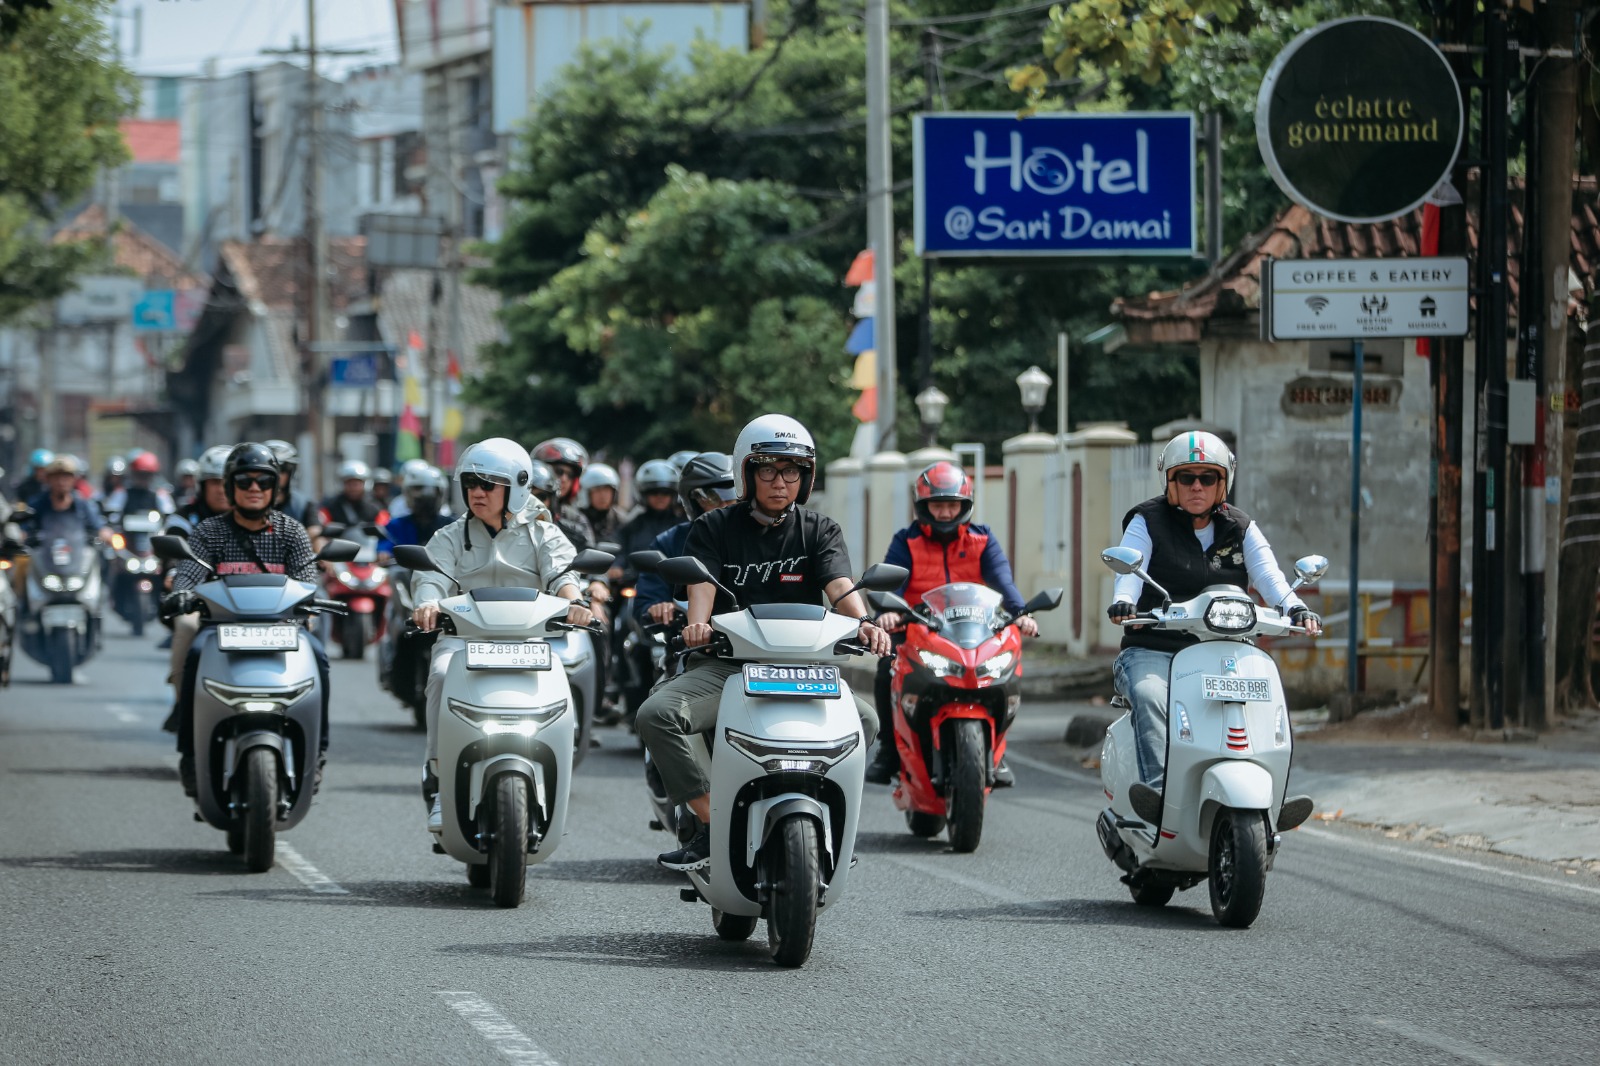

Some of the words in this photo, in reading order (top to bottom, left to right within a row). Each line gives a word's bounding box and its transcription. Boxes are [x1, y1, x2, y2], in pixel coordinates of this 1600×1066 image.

[1288, 117, 1438, 148] gourmand
[964, 128, 1149, 195] Hotel
[944, 205, 1051, 241] @Sari
[1058, 205, 1171, 240] Damai
[1292, 270, 1357, 284] COFFEE
[1369, 270, 1380, 282] &
[1389, 269, 1452, 283] EATERY
[774, 431, 798, 440] SNAIL
[223, 627, 238, 638] BE
[488, 645, 519, 655] 2898
[523, 645, 547, 656] DCV
[749, 667, 768, 679] BE
[770, 668, 806, 680] 2818
[807, 669, 835, 680] AIS
[1205, 679, 1219, 691] BE
[1219, 680, 1246, 692] 3636
[1248, 682, 1268, 694] BBR
